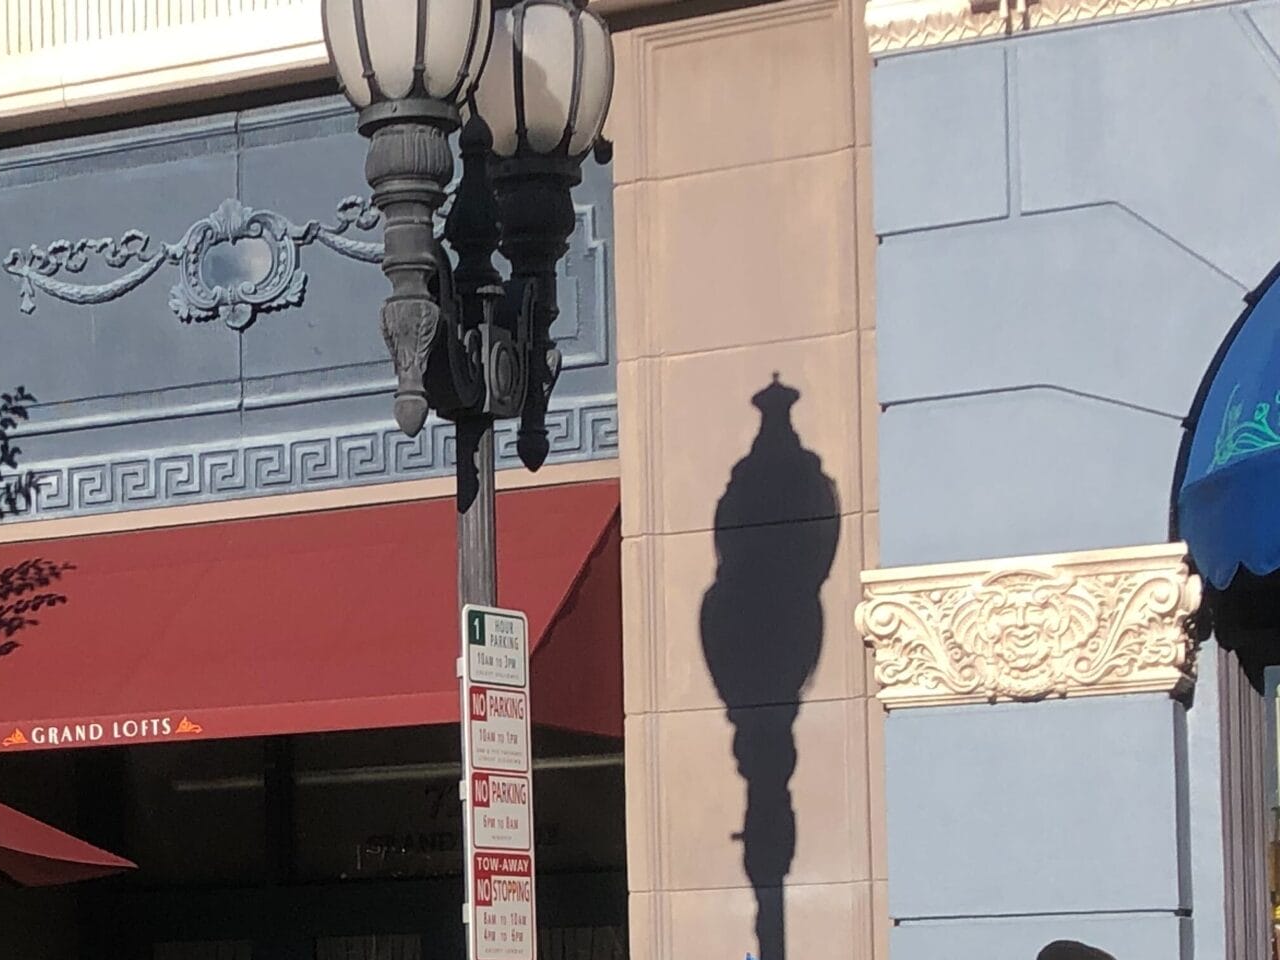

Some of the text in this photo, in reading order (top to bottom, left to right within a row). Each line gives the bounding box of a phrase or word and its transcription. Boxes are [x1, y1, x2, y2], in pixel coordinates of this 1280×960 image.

[473, 617, 514, 640] 1 HOUR
[490, 634, 519, 651] PARKING
[472, 693, 524, 720] NO PARKING
[31, 717, 171, 745] GRAND LOFTS
[475, 779, 527, 805] NO PARKING
[476, 856, 529, 873] TOW-AWAY
[477, 878, 530, 903] NO STOPPING
